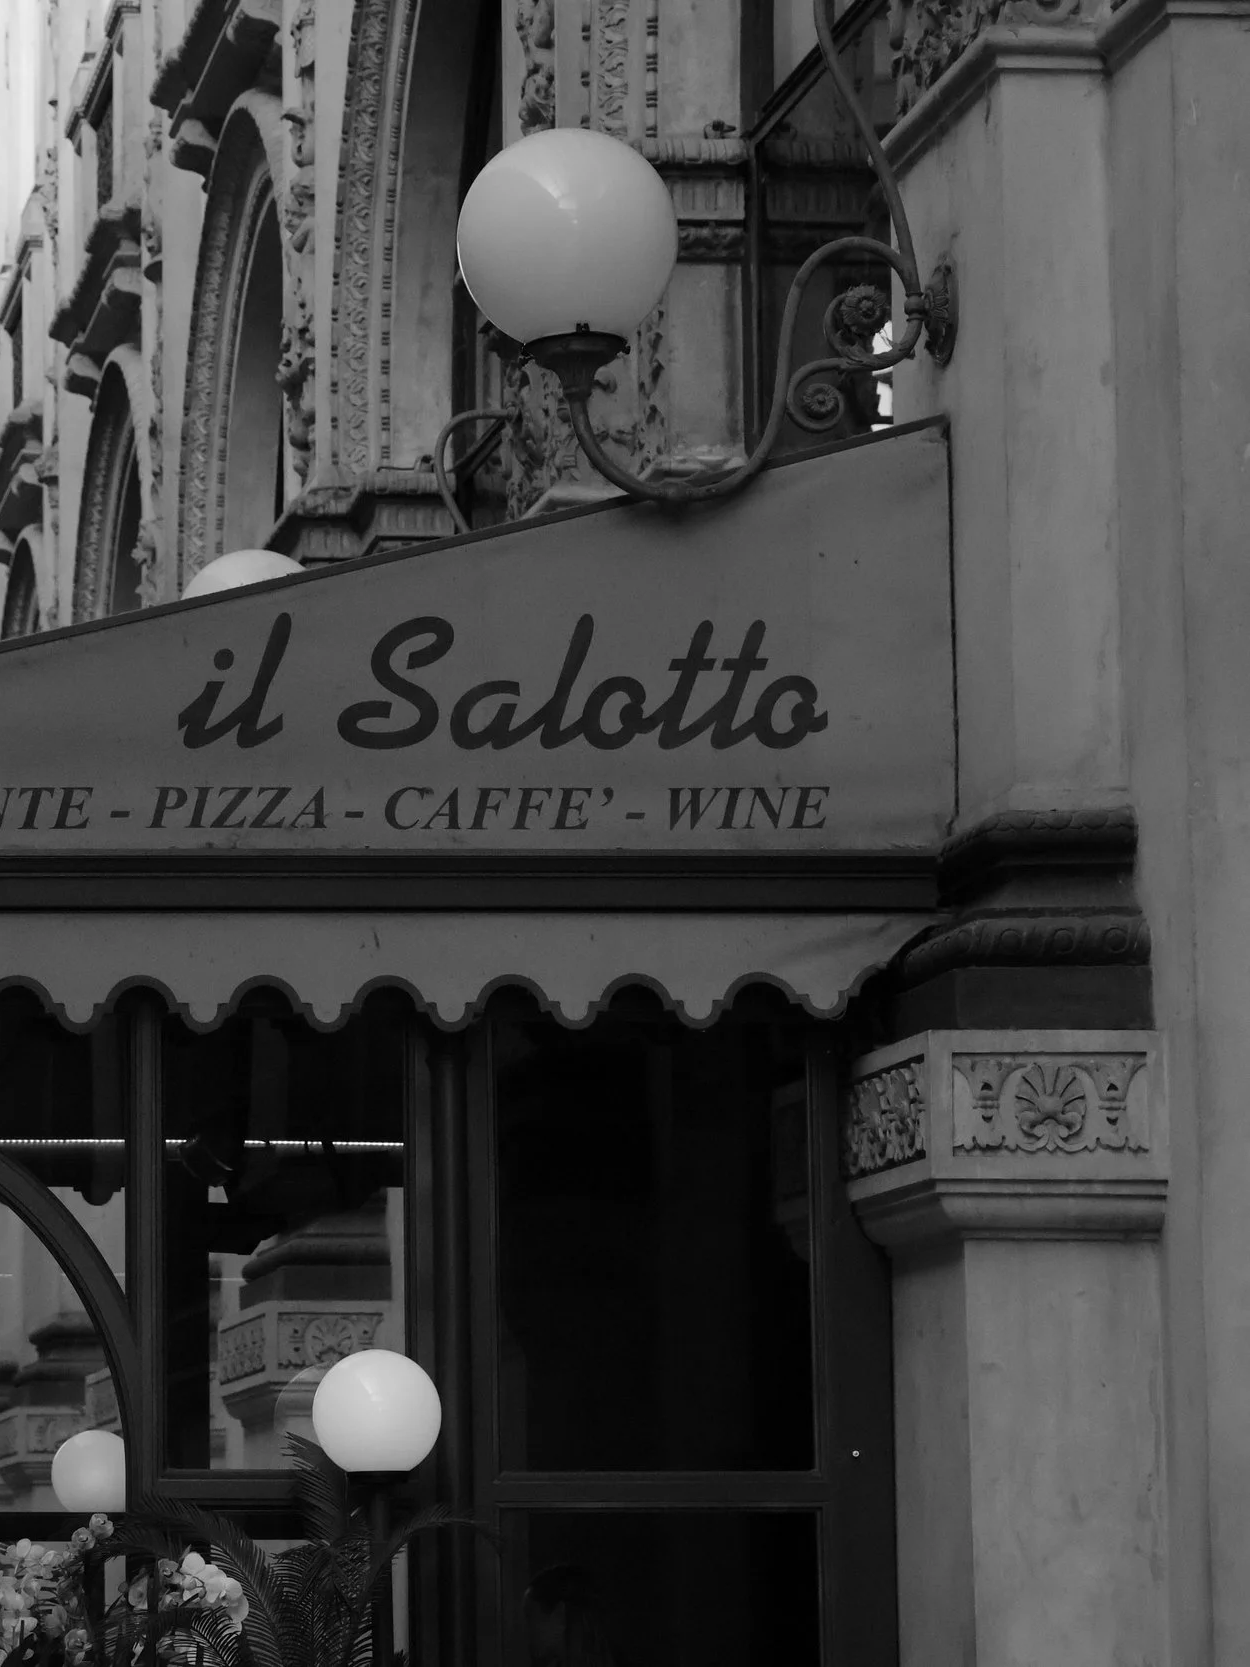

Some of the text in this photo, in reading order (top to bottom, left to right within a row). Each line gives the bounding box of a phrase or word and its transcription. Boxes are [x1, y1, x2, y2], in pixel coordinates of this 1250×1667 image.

[177, 612, 828, 751] il Salotto
[146, 786, 327, 831] PIZZA
[668, 786, 830, 831] WINE
